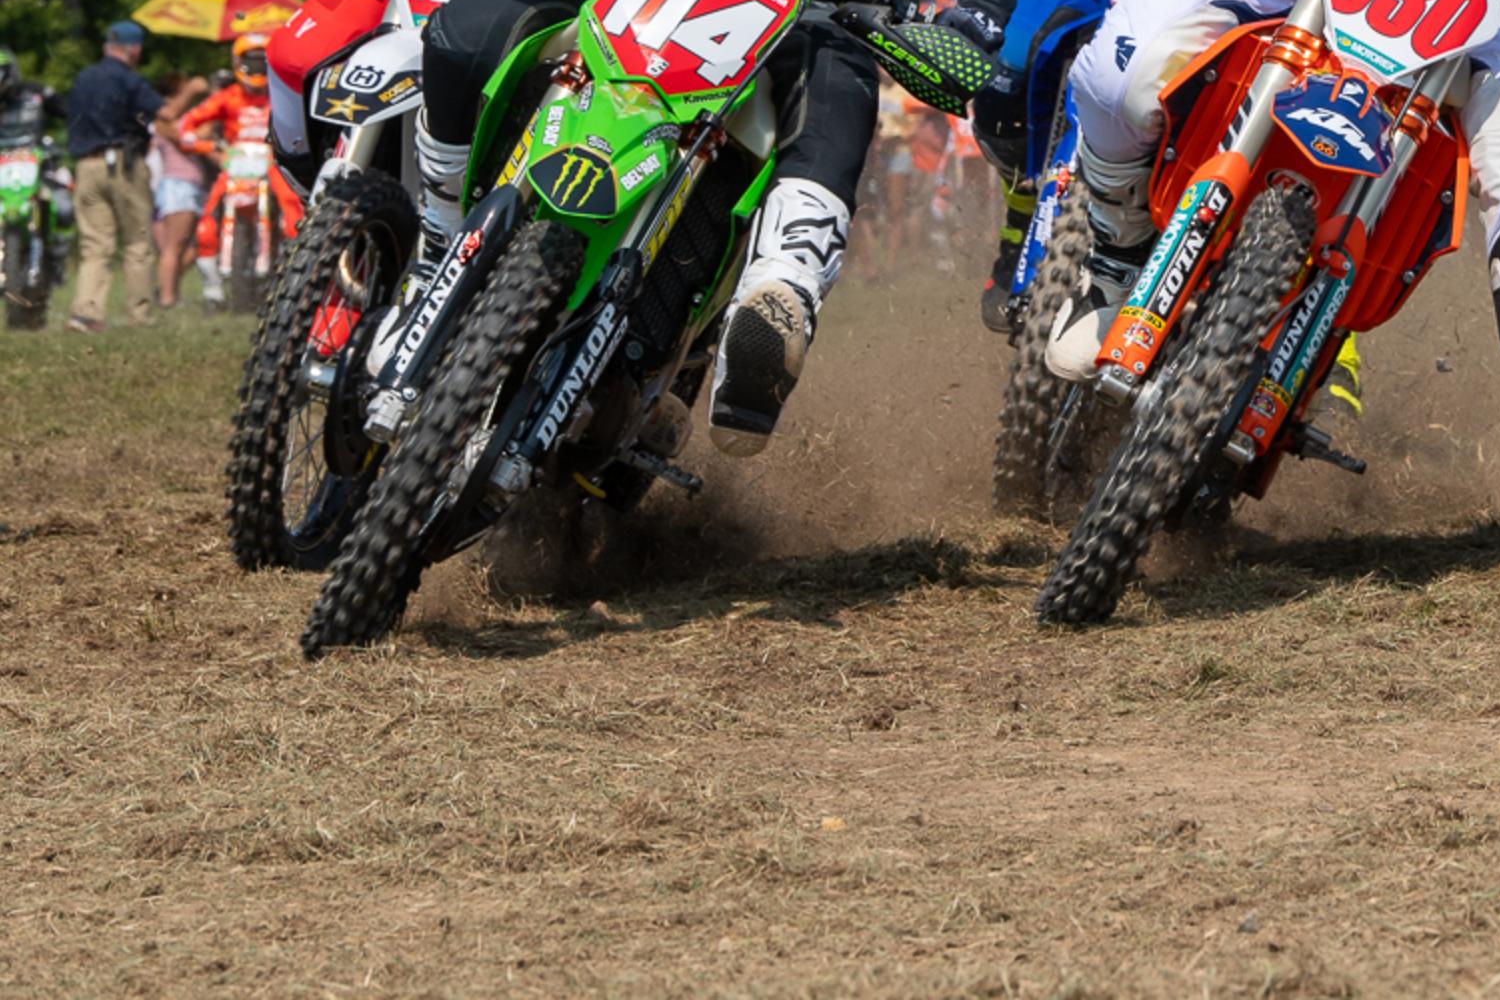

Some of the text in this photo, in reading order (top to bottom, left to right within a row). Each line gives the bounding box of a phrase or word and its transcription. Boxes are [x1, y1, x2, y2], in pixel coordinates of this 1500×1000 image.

[866, 30, 943, 85] ACERBIS
[1350, 41, 1398, 74] MOTOREX
[1286, 107, 1376, 161] KTM
[1130, 213, 1188, 302] MOTOREX
[1157, 187, 1228, 316] DNLOP
[1301, 278, 1351, 371] MOTOREX
[536, 302, 617, 451] DUNLOP
